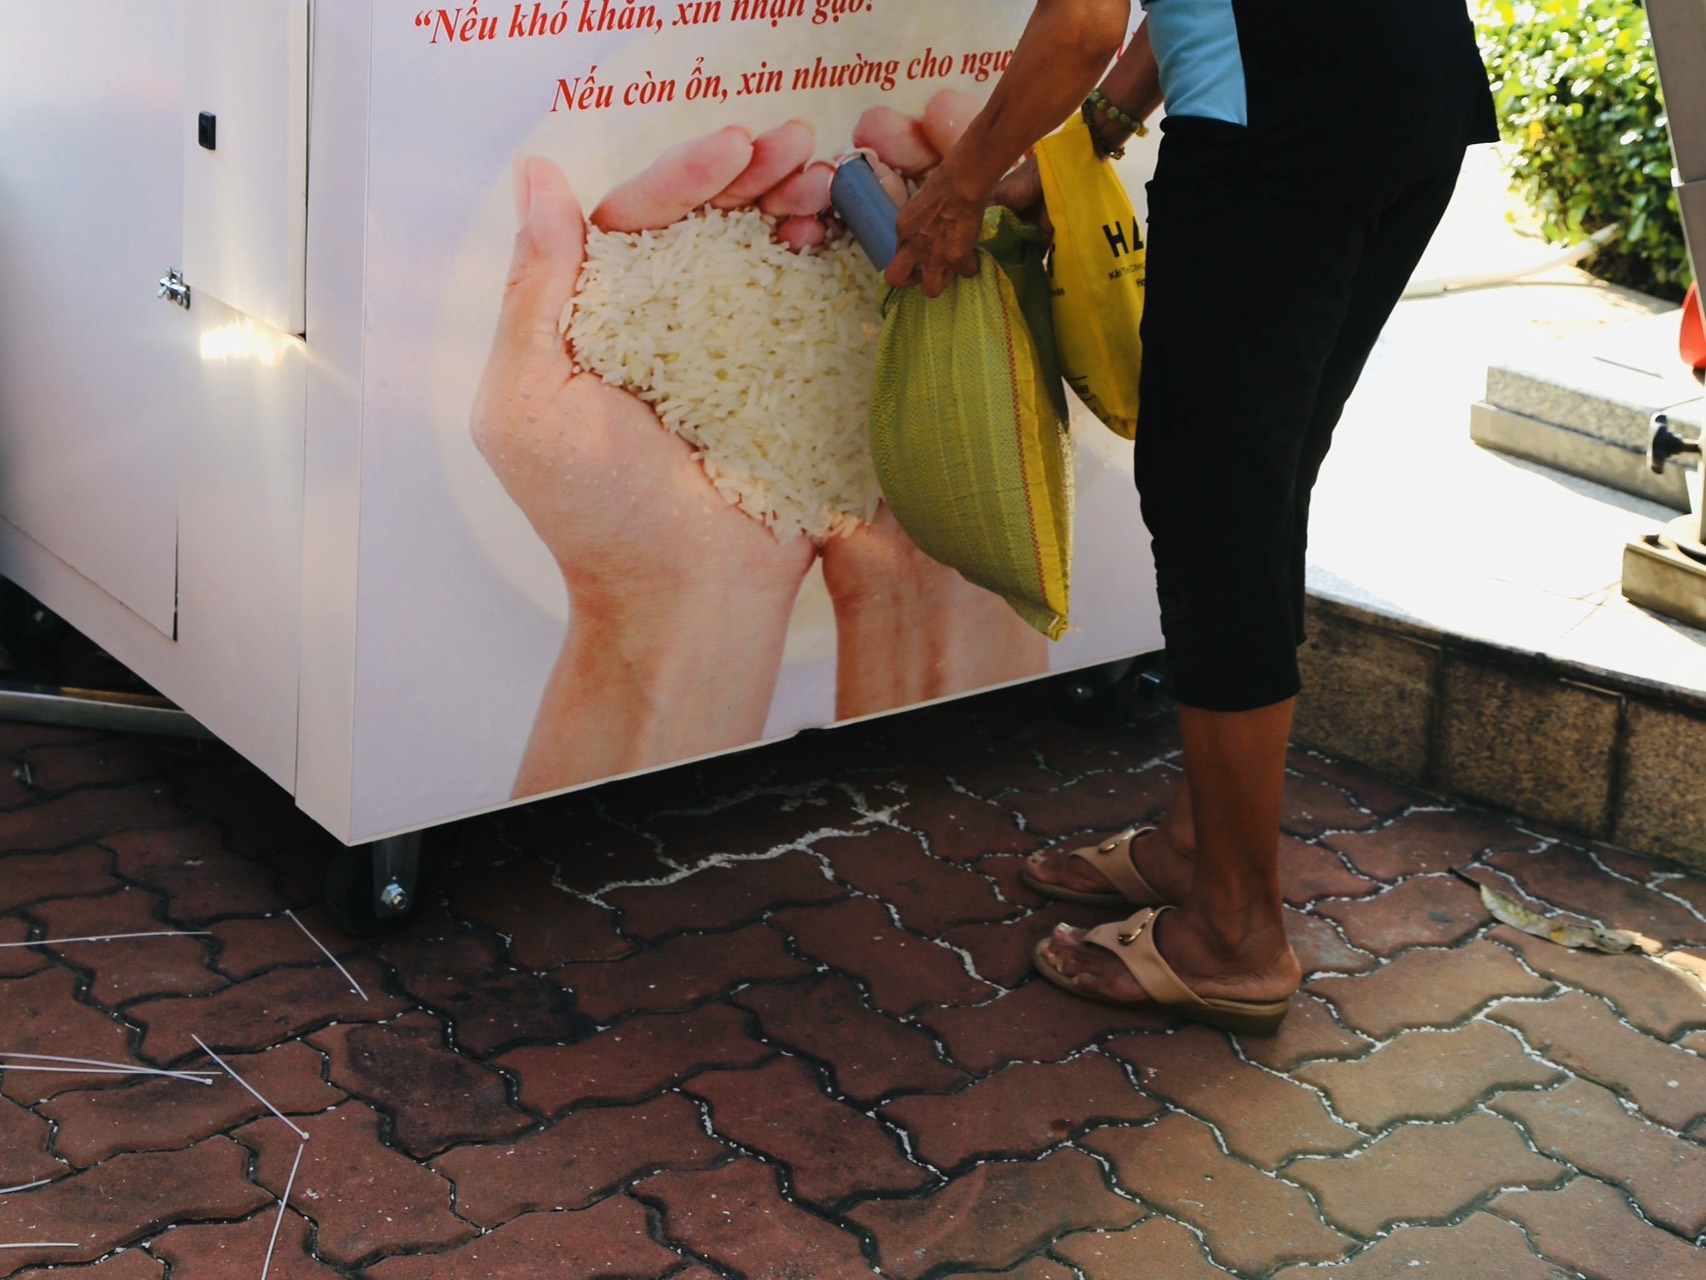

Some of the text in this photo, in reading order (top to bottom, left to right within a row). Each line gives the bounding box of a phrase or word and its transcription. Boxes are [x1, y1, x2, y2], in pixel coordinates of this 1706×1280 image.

[507, 0, 569, 39] khó
[550, 46, 1014, 113] Nếu còn ổn, xin nhường cho ngư
